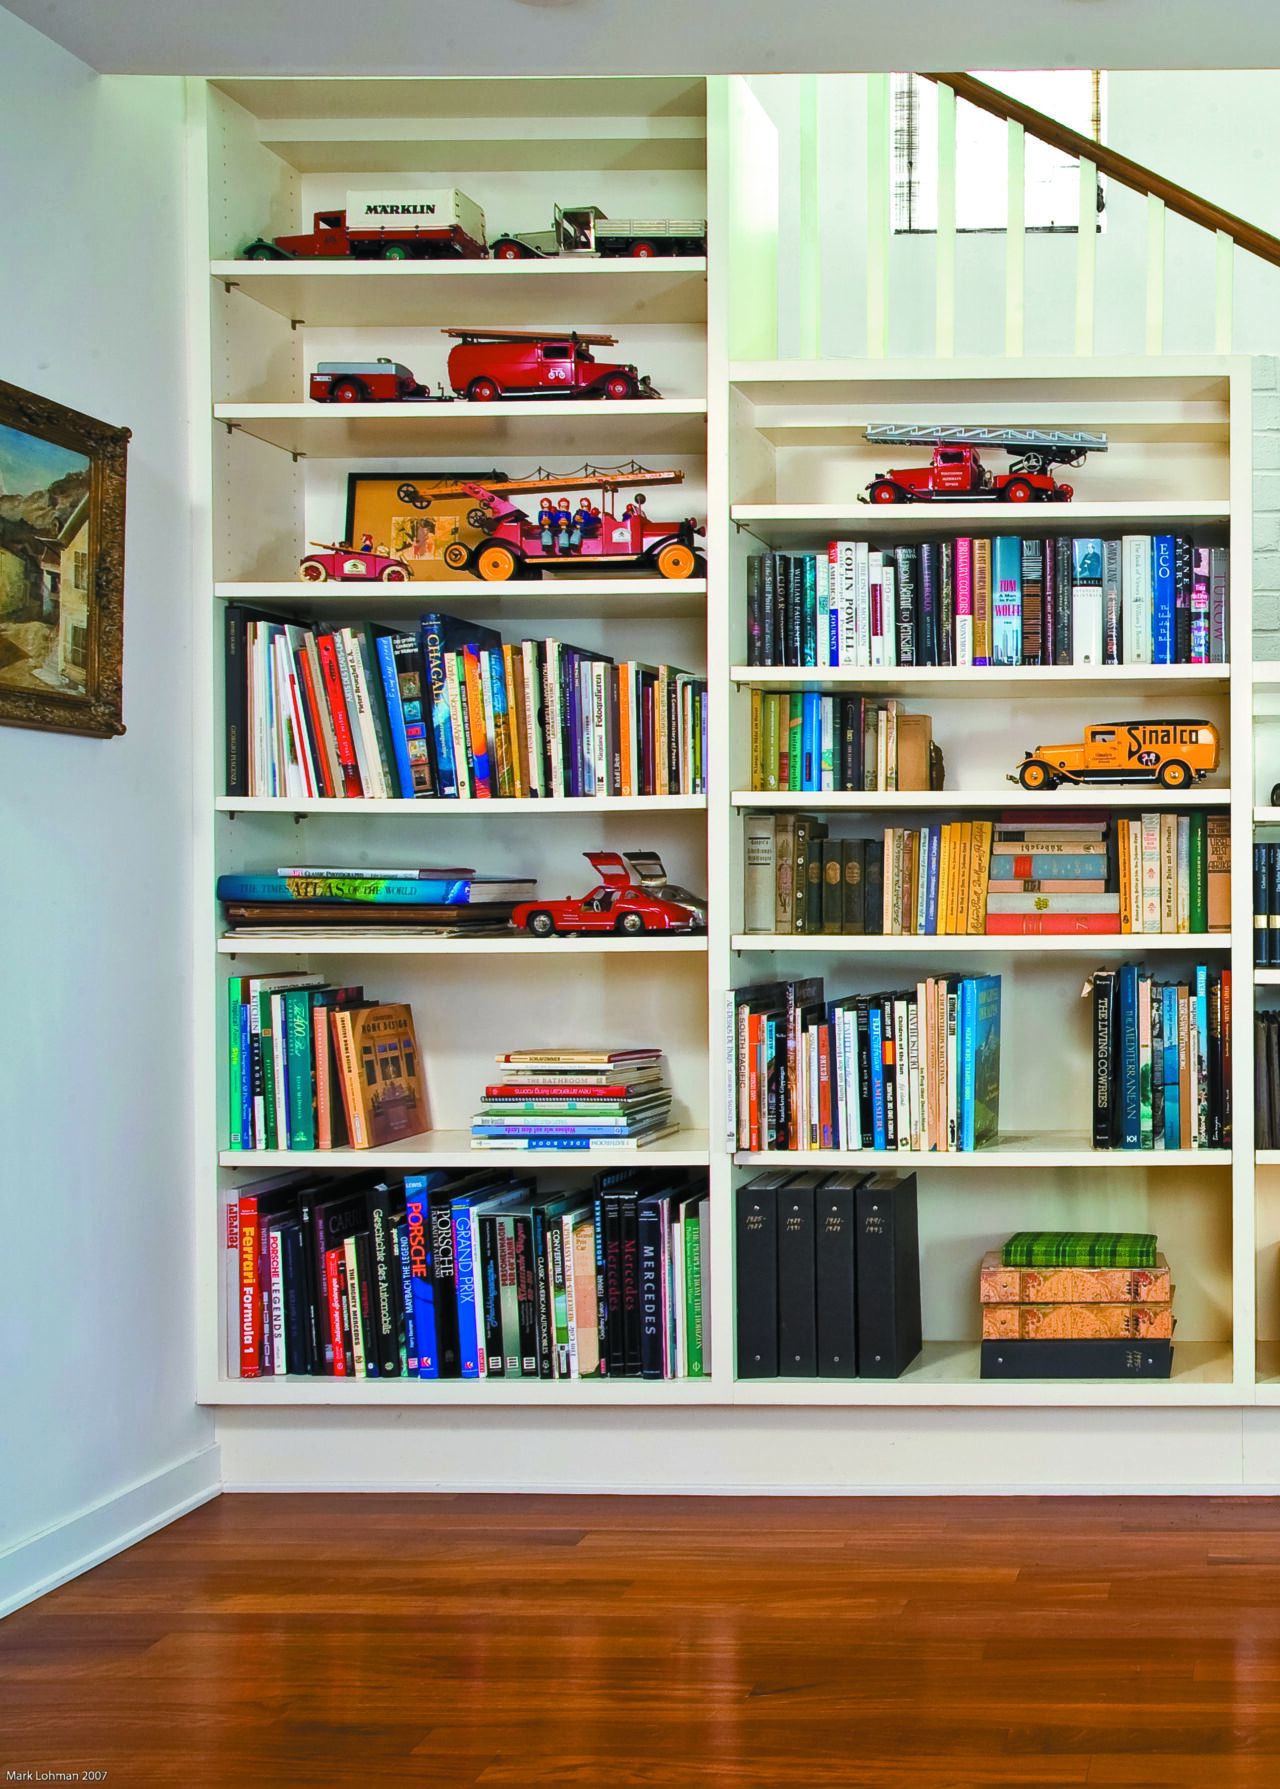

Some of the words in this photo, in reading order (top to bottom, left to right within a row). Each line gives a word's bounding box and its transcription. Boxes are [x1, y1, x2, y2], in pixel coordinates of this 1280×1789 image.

[364, 202, 436, 215] MÄRKLIN
[959, 541, 968, 579] PRIMARY
[977, 542, 986, 552] THE
[977, 552, 986, 565] LAST
[1158, 543, 1170, 579] ECO
[844, 547, 853, 592] COLIN
[900, 583, 912, 609] Beirut
[959, 580, 968, 614] COLORS
[995, 605, 1021, 616] WOLFE
[1213, 571, 1226, 643] TUROW
[844, 598, 854, 652] POWELL
[897, 622, 914, 661] Jerusalem
[959, 616, 967, 660] ANONYMOUS
[595, 674, 604, 728] Fotografieren
[1126, 726, 1199, 761] Sinalco
[240, 883, 257, 893] THE
[262, 883, 289, 894] TIMES
[291, 880, 346, 897] ATLAS
[385, 886, 417, 896] WORLD
[251, 995, 259, 1031] KITCHEN
[1098, 998, 1107, 1020] THE
[899, 1042, 904, 1050] of
[909, 1009, 918, 1071] DEUTSCHLAND
[1097, 1021, 1108, 1059] LIVING
[1097, 1059, 1108, 1108] COWRIES
[1126, 1025, 1137, 1121] MEDITERRANEAN
[373, 1209, 387, 1262] Geschichte
[401, 1237, 410, 1264] LEGEND
[407, 1202, 427, 1277] PORSCHE
[436, 1209, 452, 1278] PORSCHE
[456, 1217, 470, 1272] GRAND
[243, 1226, 256, 1284] Ferrari
[270, 1235, 280, 1278] PORSCHE
[378, 1264, 388, 1281] des
[402, 1266, 411, 1280] THE
[538, 1256, 546, 1279] CLASSIC
[552, 1229, 563, 1284] CONVERTIBLES
[460, 1277, 474, 1304] PRIX
[607, 1240, 619, 1311] Mercedes
[624, 1239, 637, 1311] Mercedes
[643, 1246, 656, 1336] MERCEDES
[273, 1281, 282, 1339] LEGENDS
[349, 1283, 357, 1308] MIGHTY
[379, 1282, 391, 1335] Automobils
[403, 1281, 413, 1313] MAYBACH
[539, 1280, 547, 1312] AMERICAN
[243, 1287, 254, 1345] Formula
[351, 1310, 360, 1346] MERCEDES
[540, 1313, 548, 1354] AUTOMOBILES
[694, 1315, 702, 1349] HORIZON
